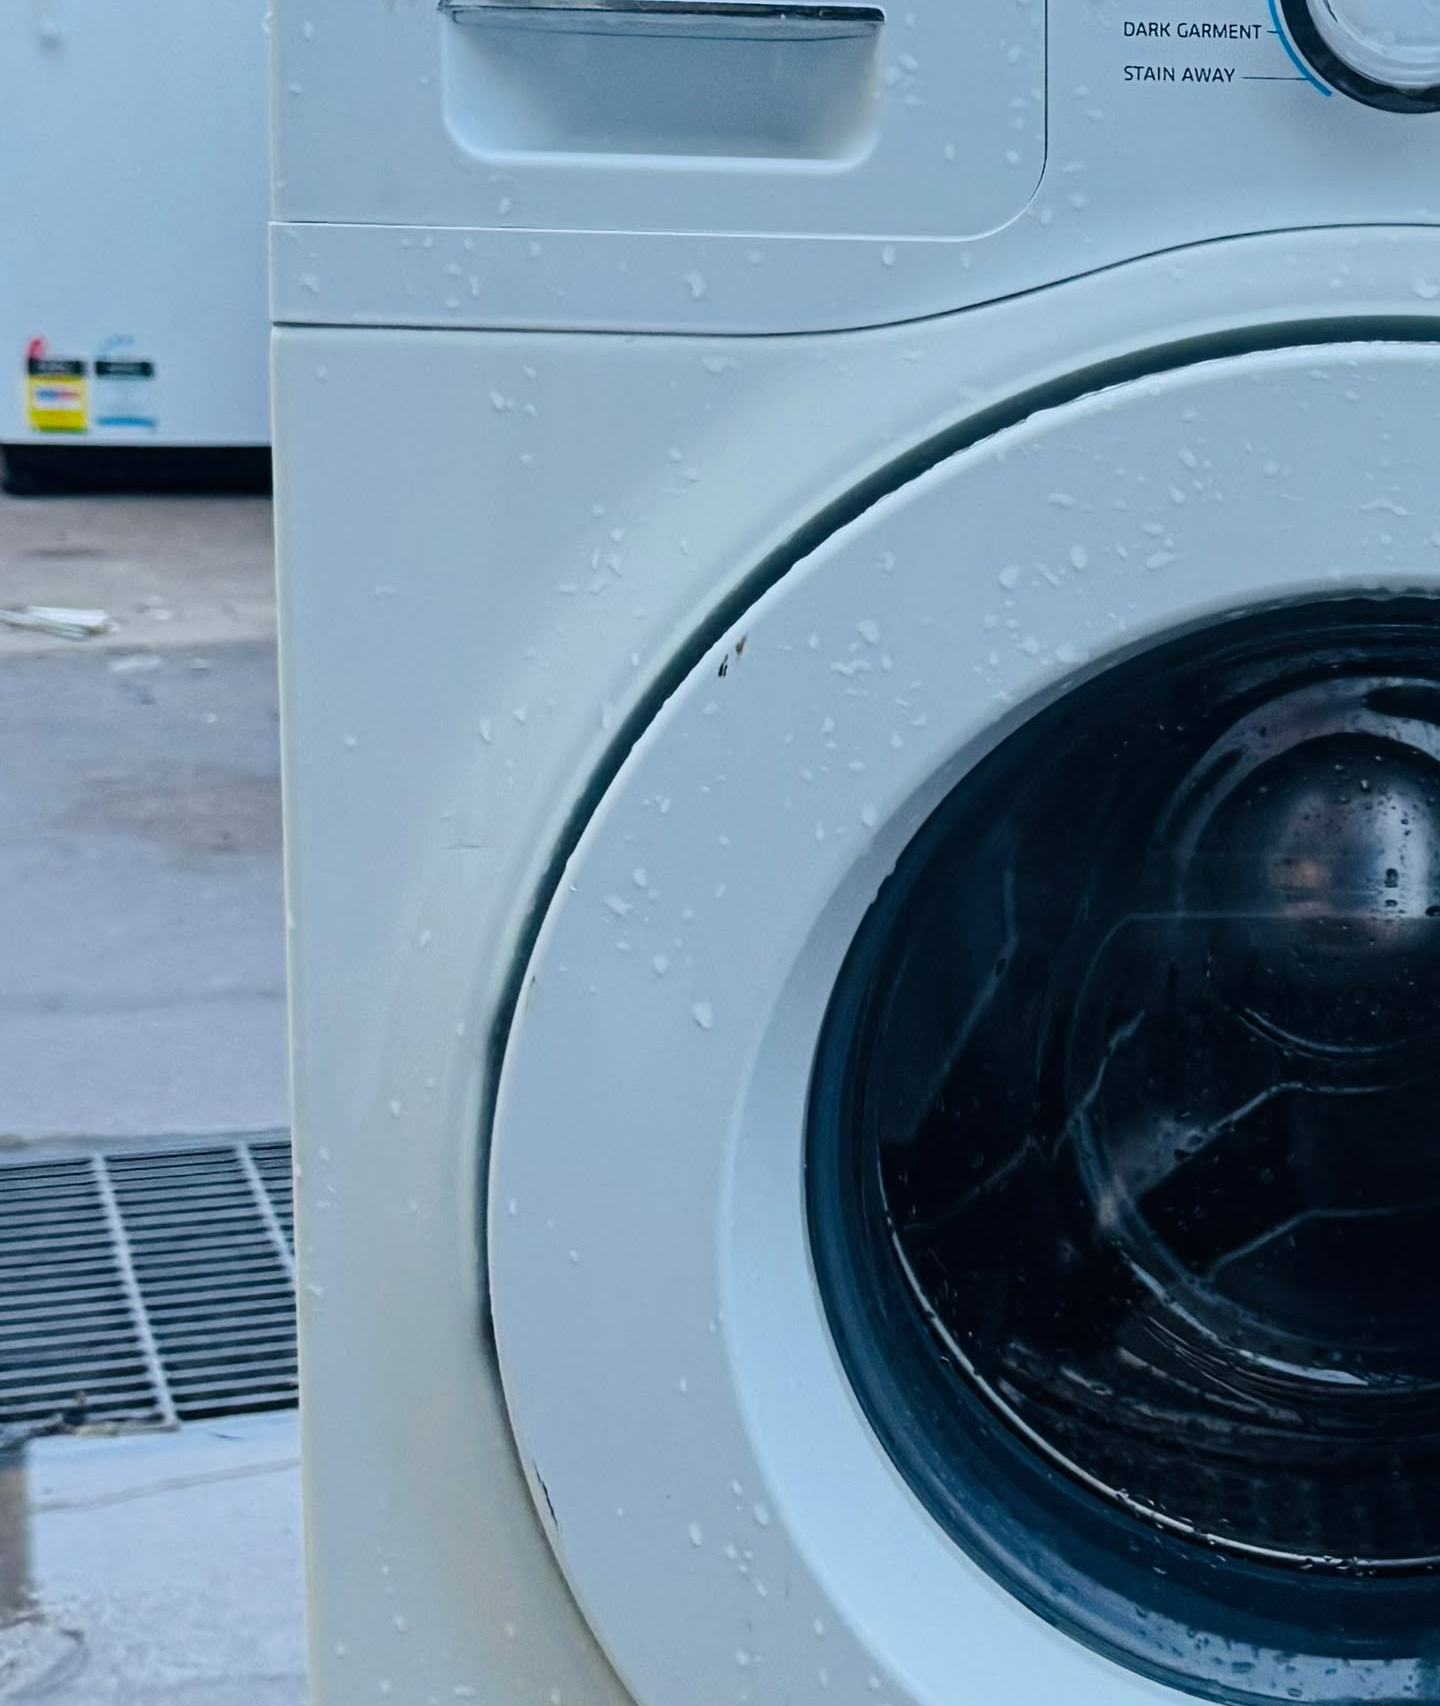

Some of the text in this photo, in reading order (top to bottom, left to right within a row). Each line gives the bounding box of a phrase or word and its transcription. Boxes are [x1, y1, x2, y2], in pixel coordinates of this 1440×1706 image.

[1123, 20, 1263, 41] DARK GARMENT
[1123, 65, 1237, 84] STAIN AWAY
